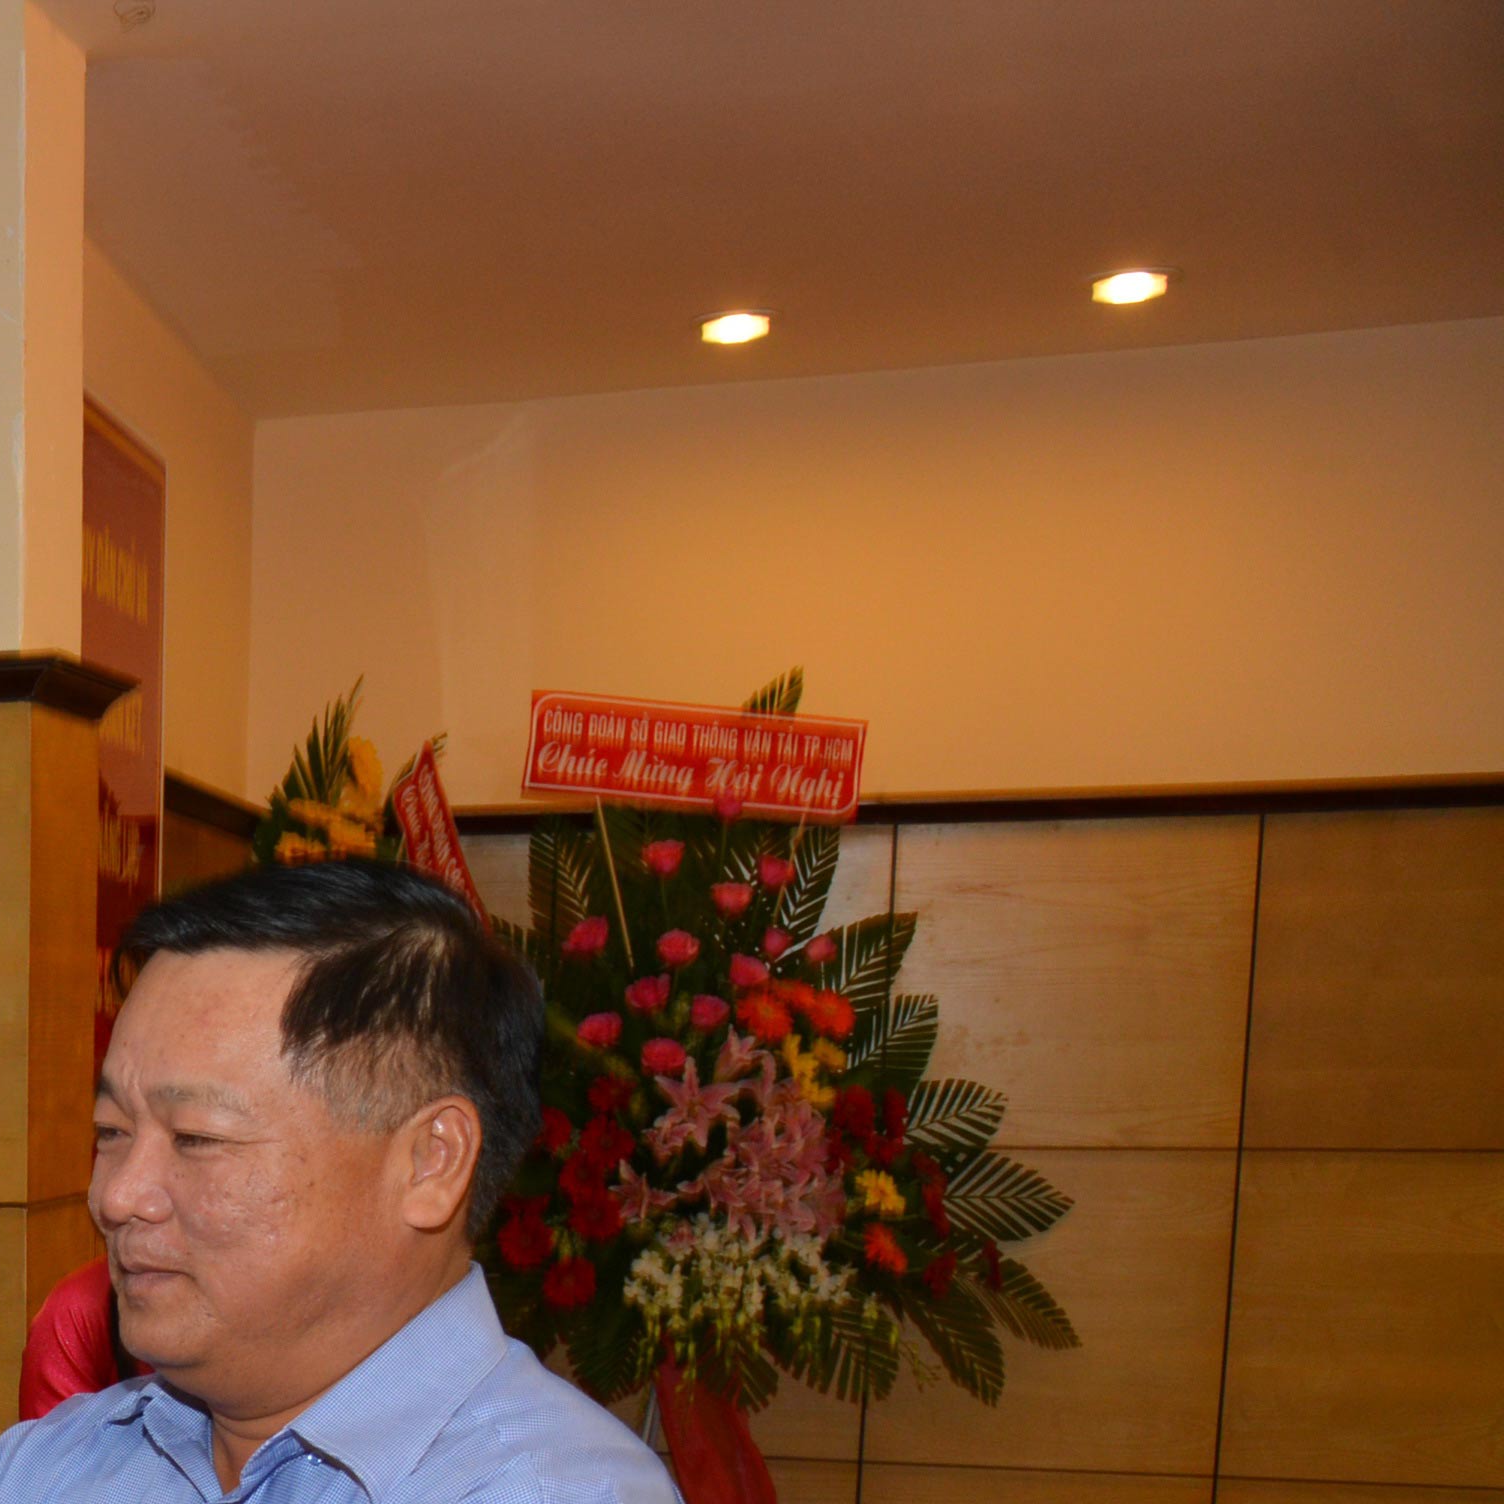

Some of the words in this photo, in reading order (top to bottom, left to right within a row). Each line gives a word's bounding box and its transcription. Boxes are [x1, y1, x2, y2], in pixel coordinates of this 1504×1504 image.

[542, 704, 584, 737] CÔNG
[630, 711, 649, 742] SỞ
[654, 721, 687, 746] GIAO
[693, 720, 738, 750] THÔNG
[744, 725, 773, 757] VẬN
[537, 741, 608, 777] Chúc
